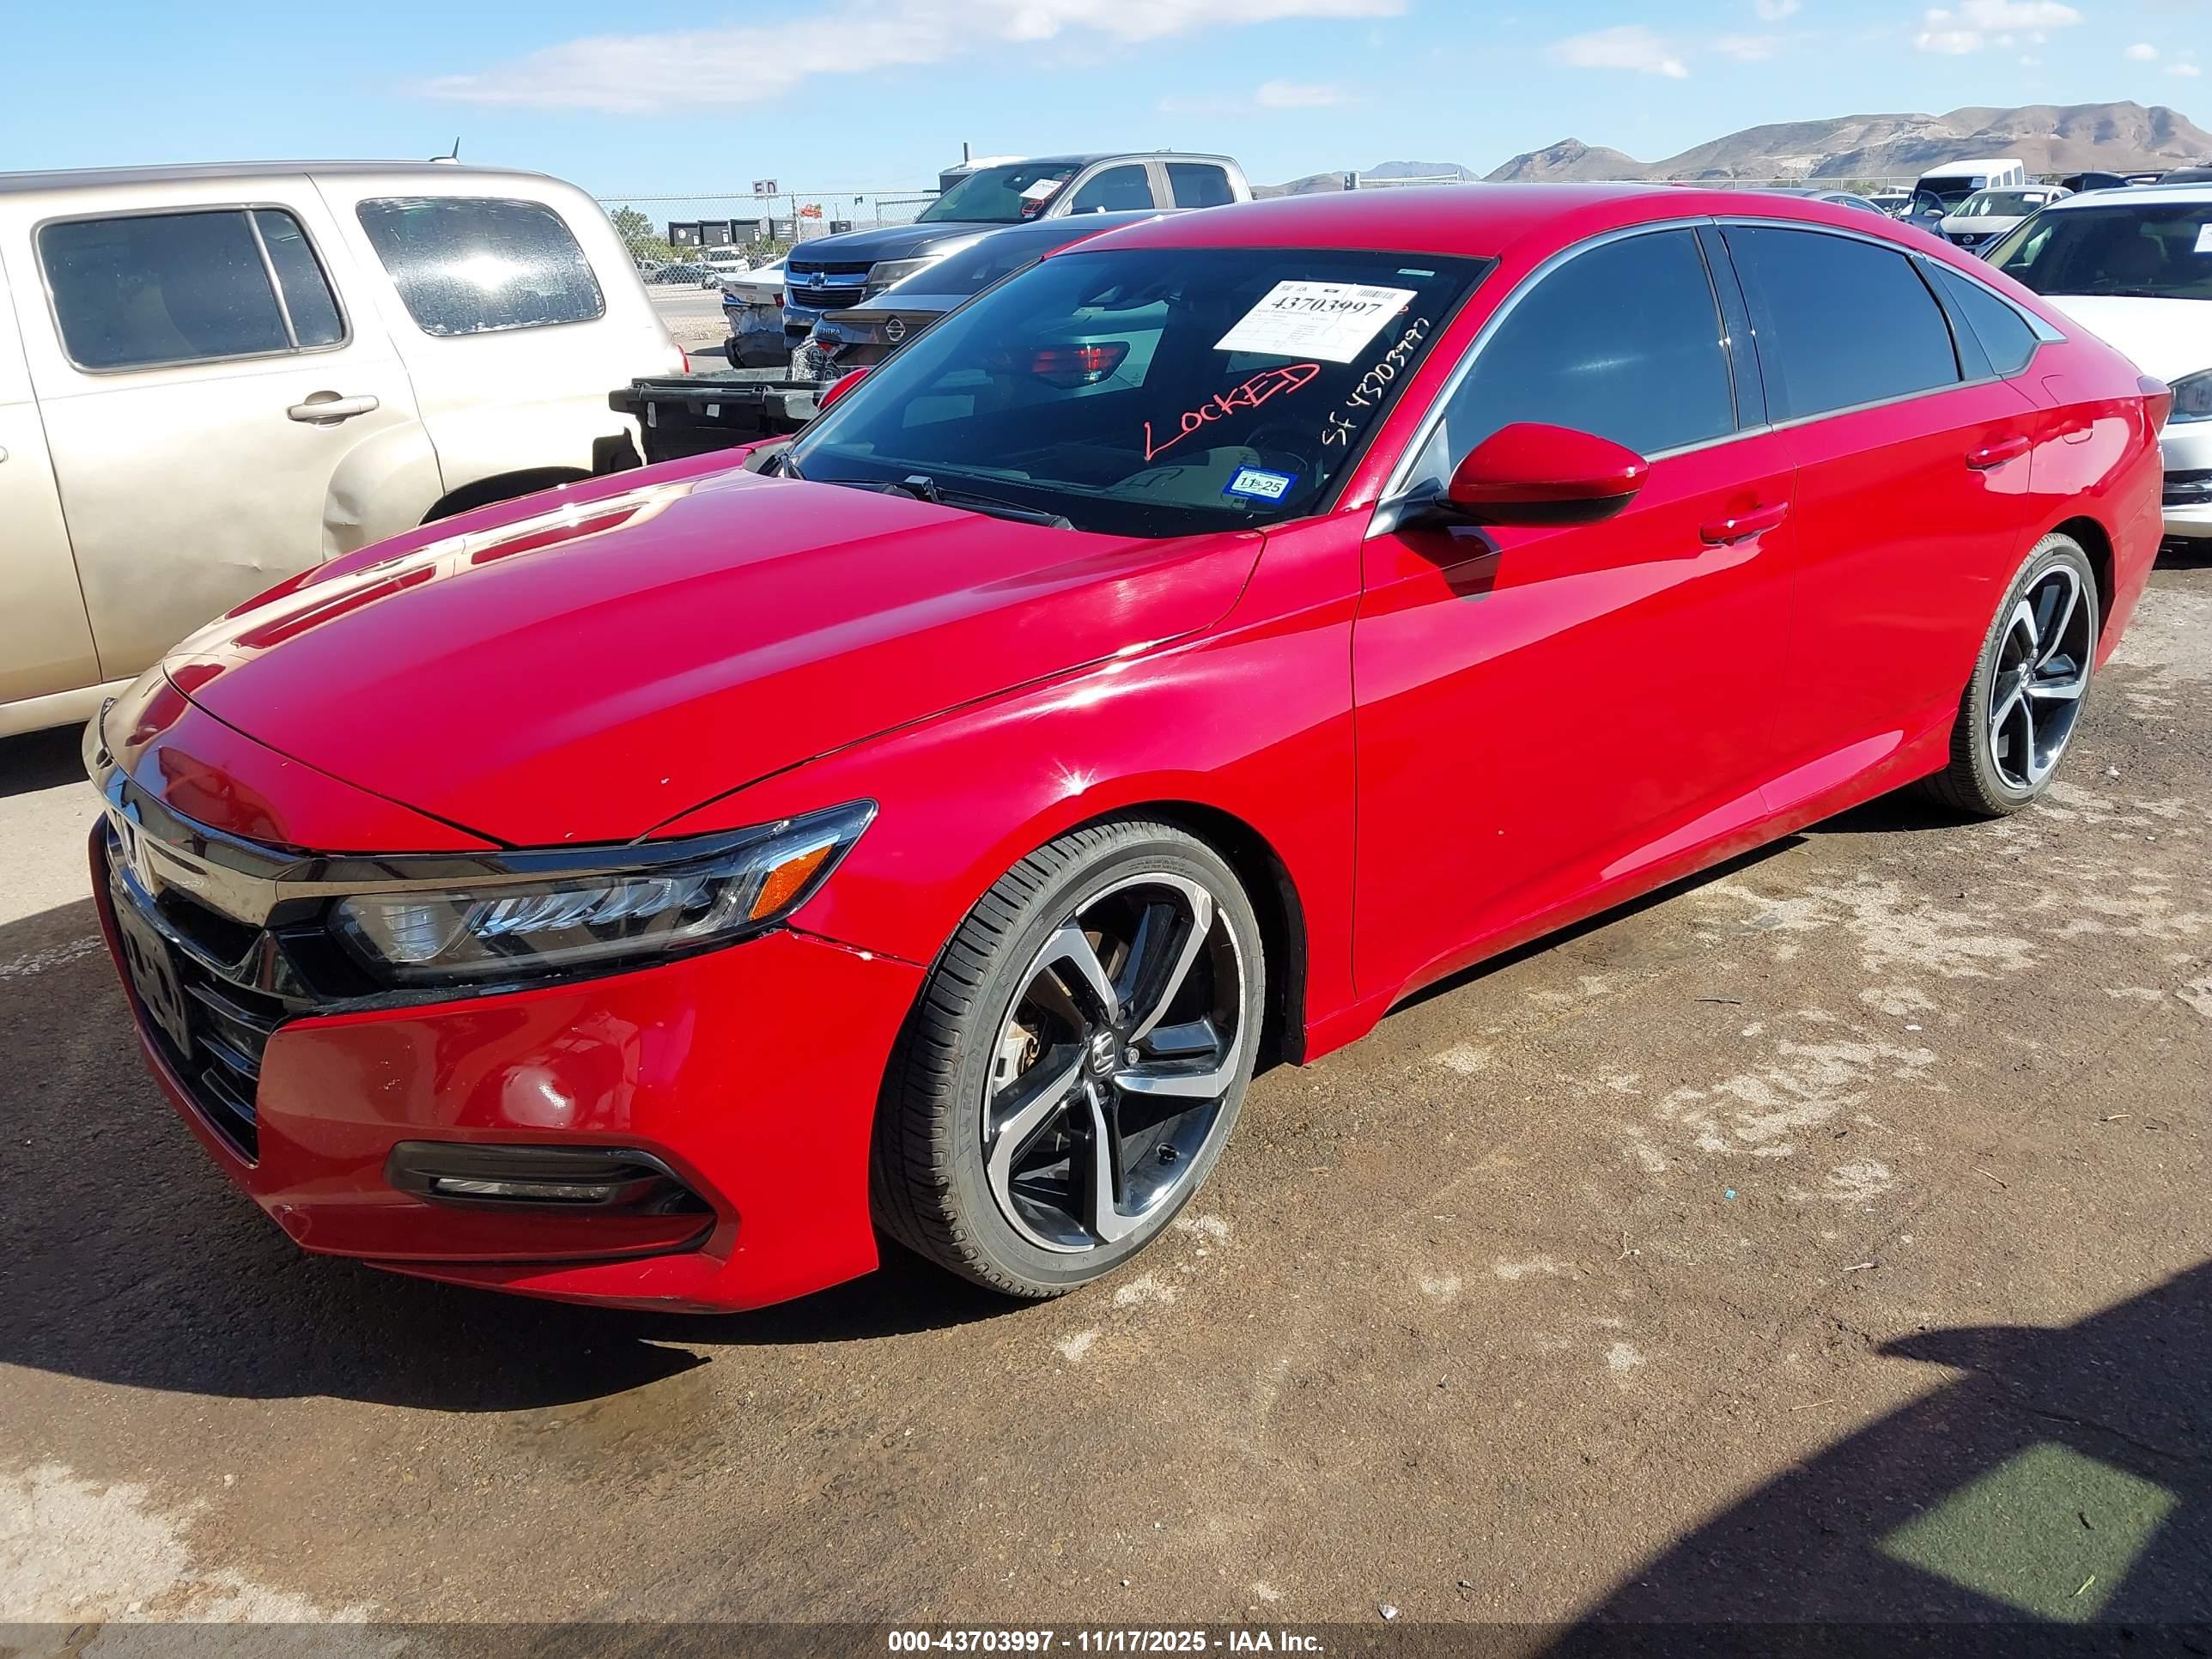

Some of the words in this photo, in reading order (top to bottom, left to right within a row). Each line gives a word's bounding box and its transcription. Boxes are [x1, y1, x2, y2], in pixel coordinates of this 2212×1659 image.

[1271, 296, 1383, 316] 43703997
[1346, 317, 1430, 406] 43703997
[1144, 363, 1321, 461] LOCKED
[1261, 481, 1283, 493] 25
